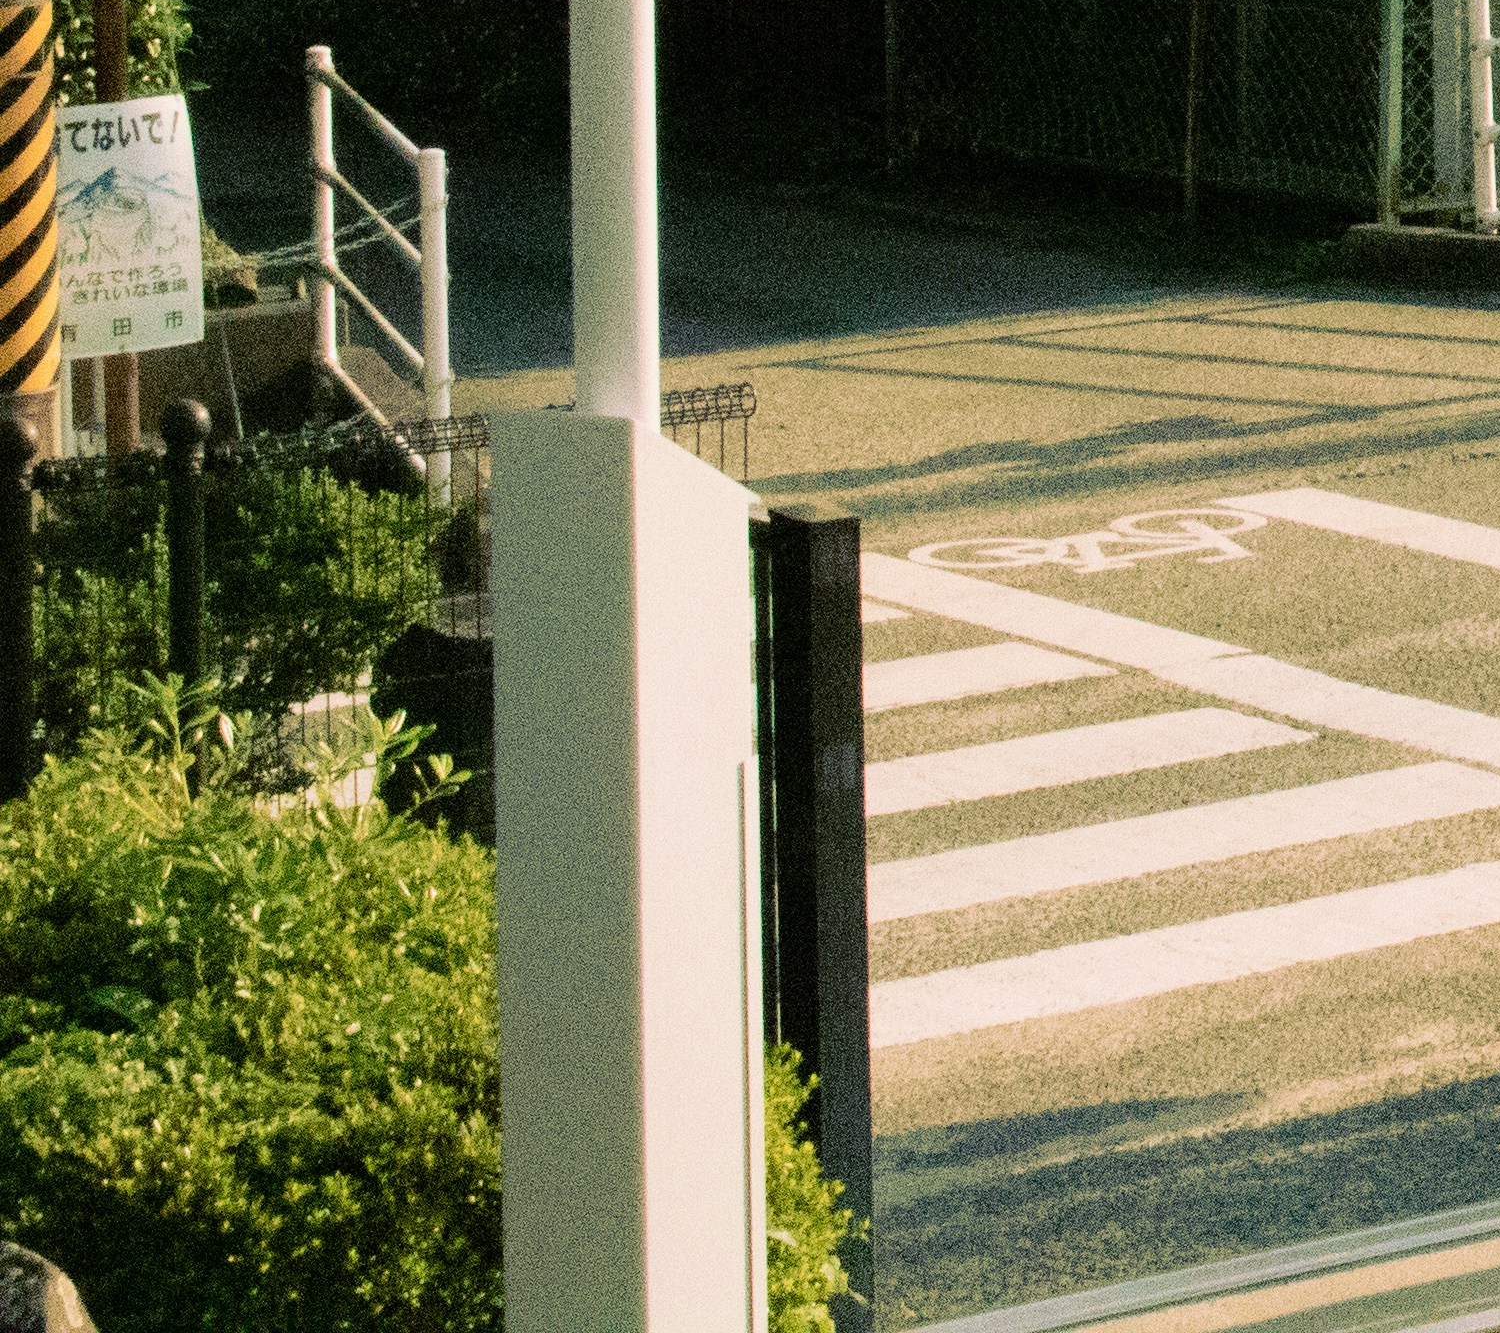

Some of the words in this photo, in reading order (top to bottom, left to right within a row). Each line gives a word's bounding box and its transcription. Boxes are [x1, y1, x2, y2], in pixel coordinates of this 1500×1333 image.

[52, 110, 180, 156] てないで!
[60, 262, 183, 288] んなで作ろう
